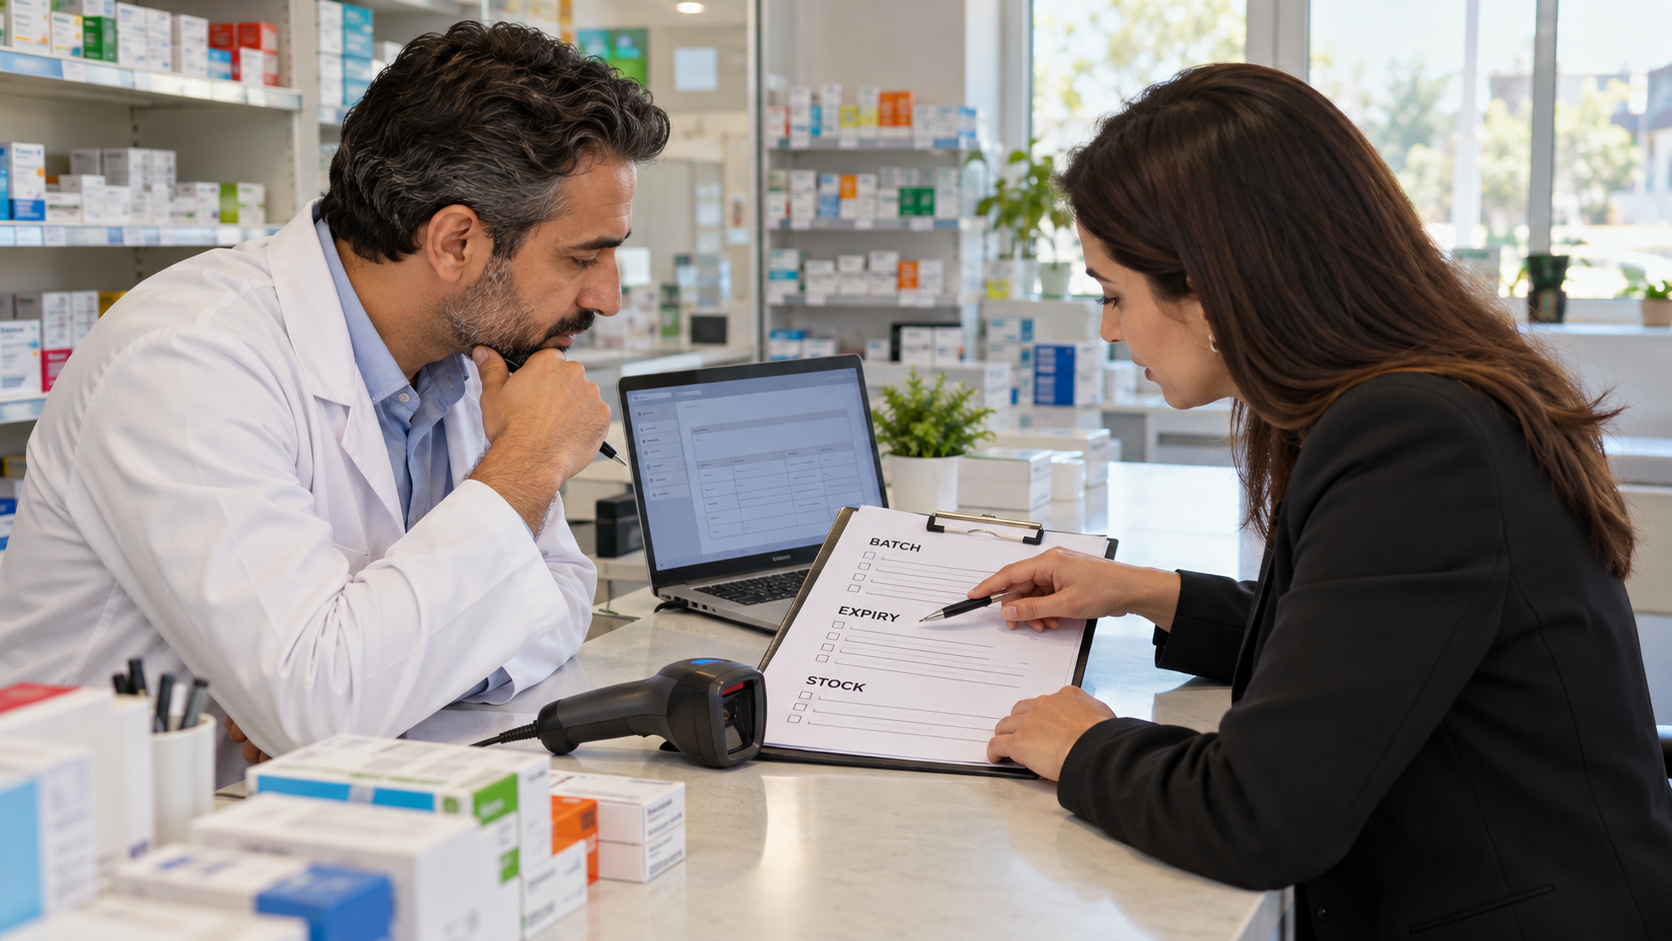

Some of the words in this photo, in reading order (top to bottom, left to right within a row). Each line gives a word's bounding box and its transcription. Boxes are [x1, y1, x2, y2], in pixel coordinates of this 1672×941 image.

[869, 537, 921, 552] BATCH
[838, 605, 900, 623] EXPIRY
[806, 675, 866, 693] STOCK
